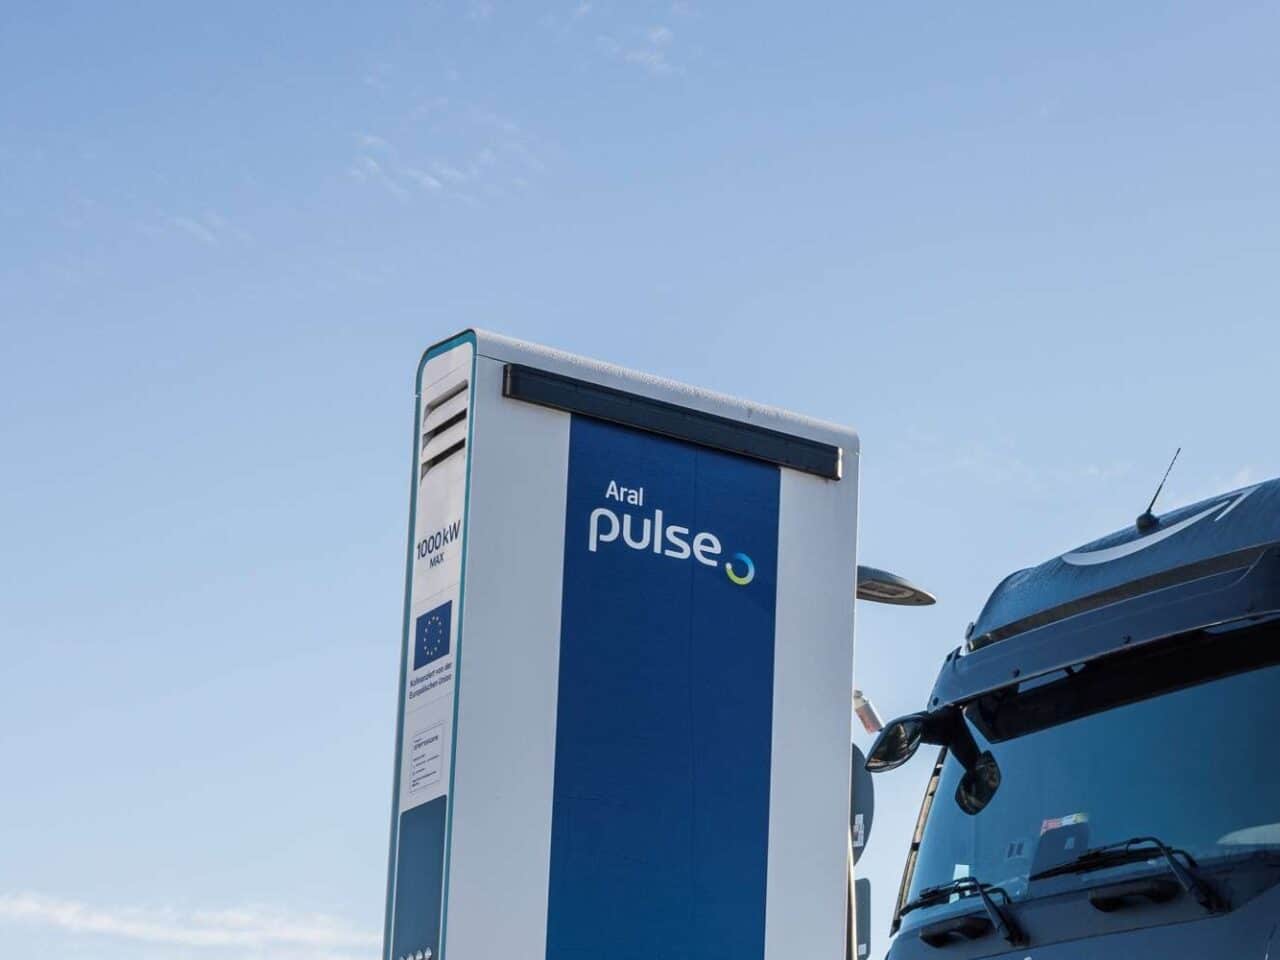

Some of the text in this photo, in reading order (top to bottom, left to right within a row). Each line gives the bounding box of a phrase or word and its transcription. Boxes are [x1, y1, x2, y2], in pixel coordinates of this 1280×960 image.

[605, 479, 644, 506] Aral
[588, 507, 722, 567] pulse
[429, 551, 445, 569] MAX
